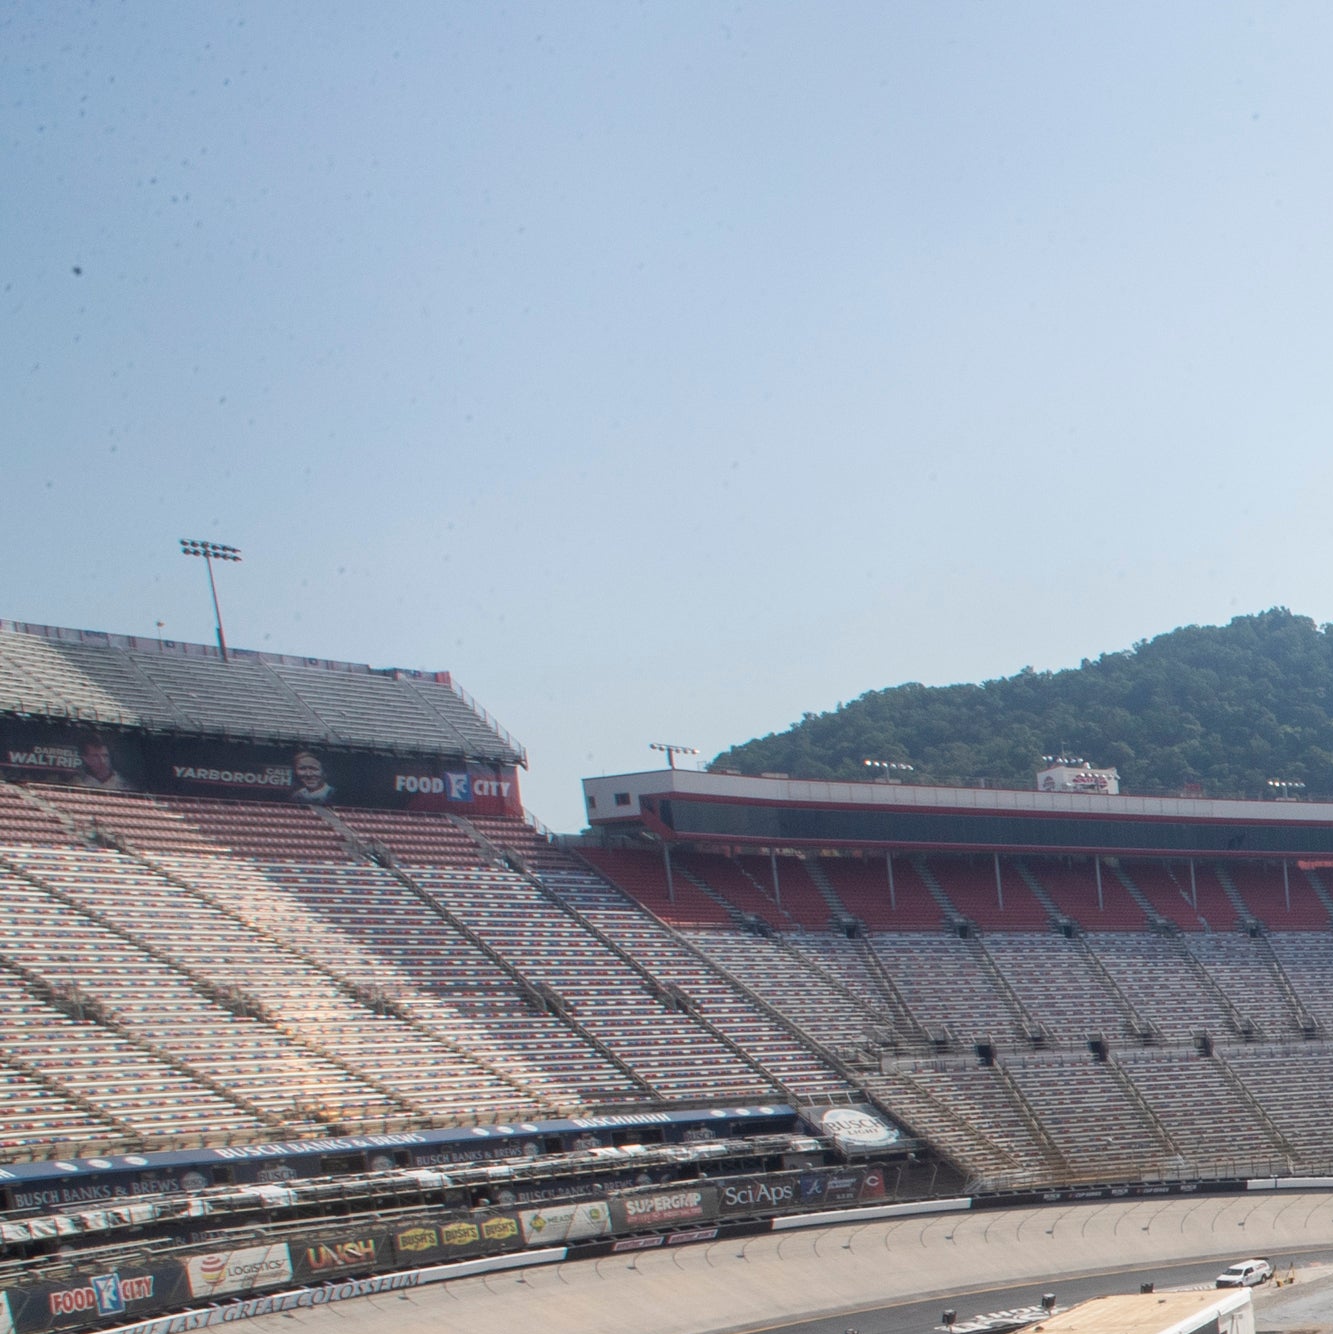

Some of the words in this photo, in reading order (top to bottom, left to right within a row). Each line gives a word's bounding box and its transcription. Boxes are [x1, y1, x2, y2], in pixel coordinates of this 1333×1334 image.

[9, 751, 83, 768] WALTRIP
[173, 766, 292, 786] YARBOROUGH
[395, 775, 444, 794] FOOD
[474, 780, 511, 797] CITY
[828, 1117, 886, 1131] BUSCH
[847, 1128, 879, 1136] LIGHT
[214, 1144, 287, 1160] BUSCH
[288, 1138, 352, 1153] BANKS
[352, 1138, 369, 1148] &
[368, 1132, 427, 1147] BREWS
[416, 1154, 449, 1167] BUSCH
[452, 1150, 484, 1162] BANKS
[494, 1147, 523, 1159] BREWS
[15, 1189, 60, 1208] BUSCH
[63, 1184, 113, 1201] BANKS
[114, 1185, 129, 1197] &
[132, 1178, 180, 1195] BREWS
[519, 1188, 555, 1203] BUSCH
[725, 1183, 794, 1207] SciAps
[446, 1226, 478, 1242] BUSH'S
[485, 1220, 516, 1235] BUSH'S
[401, 1231, 436, 1247] BUSH'S
[228, 1260, 282, 1278] LOGISTICS
[50, 1287, 95, 1315] FOOD
[121, 1275, 154, 1301] CITY
[164, 1309, 215, 1334] LAST
[221, 1293, 290, 1322] GREAT
[295, 1272, 422, 1308] COLOSSEUM
